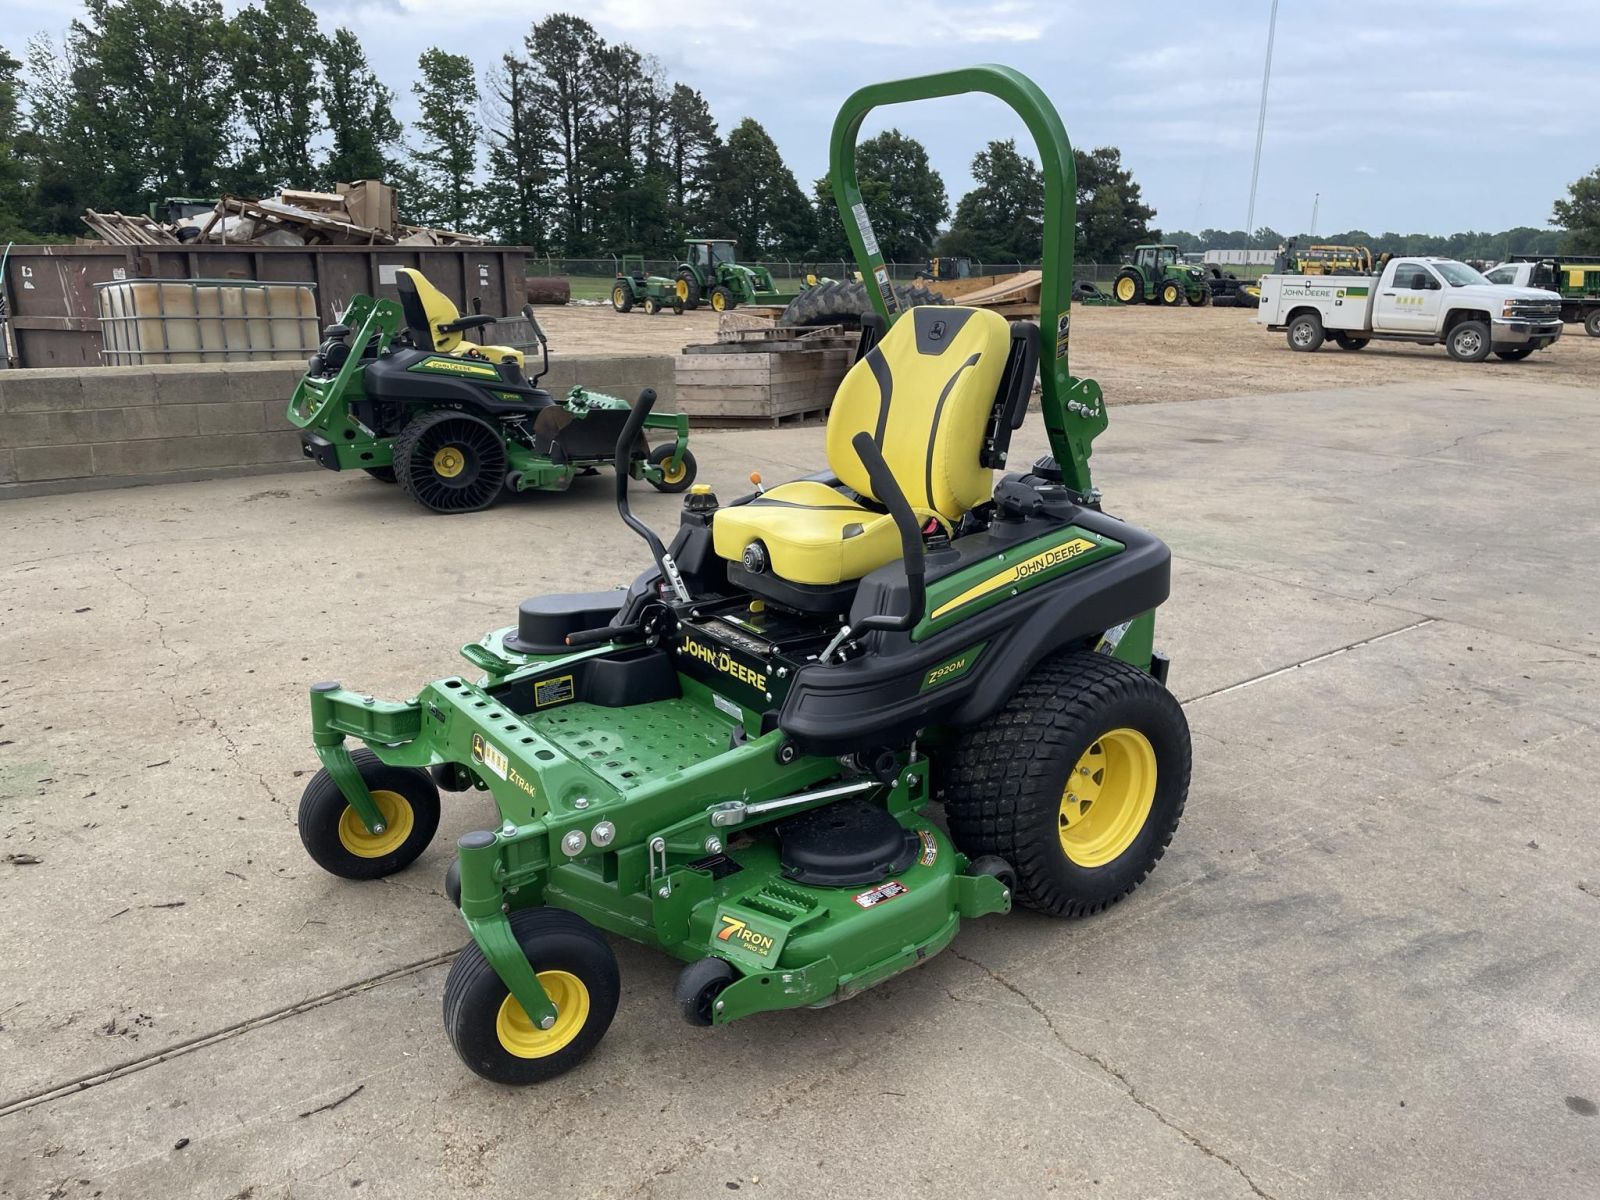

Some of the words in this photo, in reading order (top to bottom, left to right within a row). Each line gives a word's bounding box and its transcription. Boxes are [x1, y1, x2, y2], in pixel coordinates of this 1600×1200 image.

[1283, 288, 1304, 296] JOHN
[1305, 289, 1331, 297] DEERE
[1013, 558, 1044, 580] JOHN
[1045, 543, 1082, 565] DEERE
[682, 635, 716, 664] JOHN
[719, 653, 767, 692] DEERE
[928, 659, 965, 684] Z920M
[508, 768, 536, 797] ZTRAK
[743, 942, 758, 952] PRO
